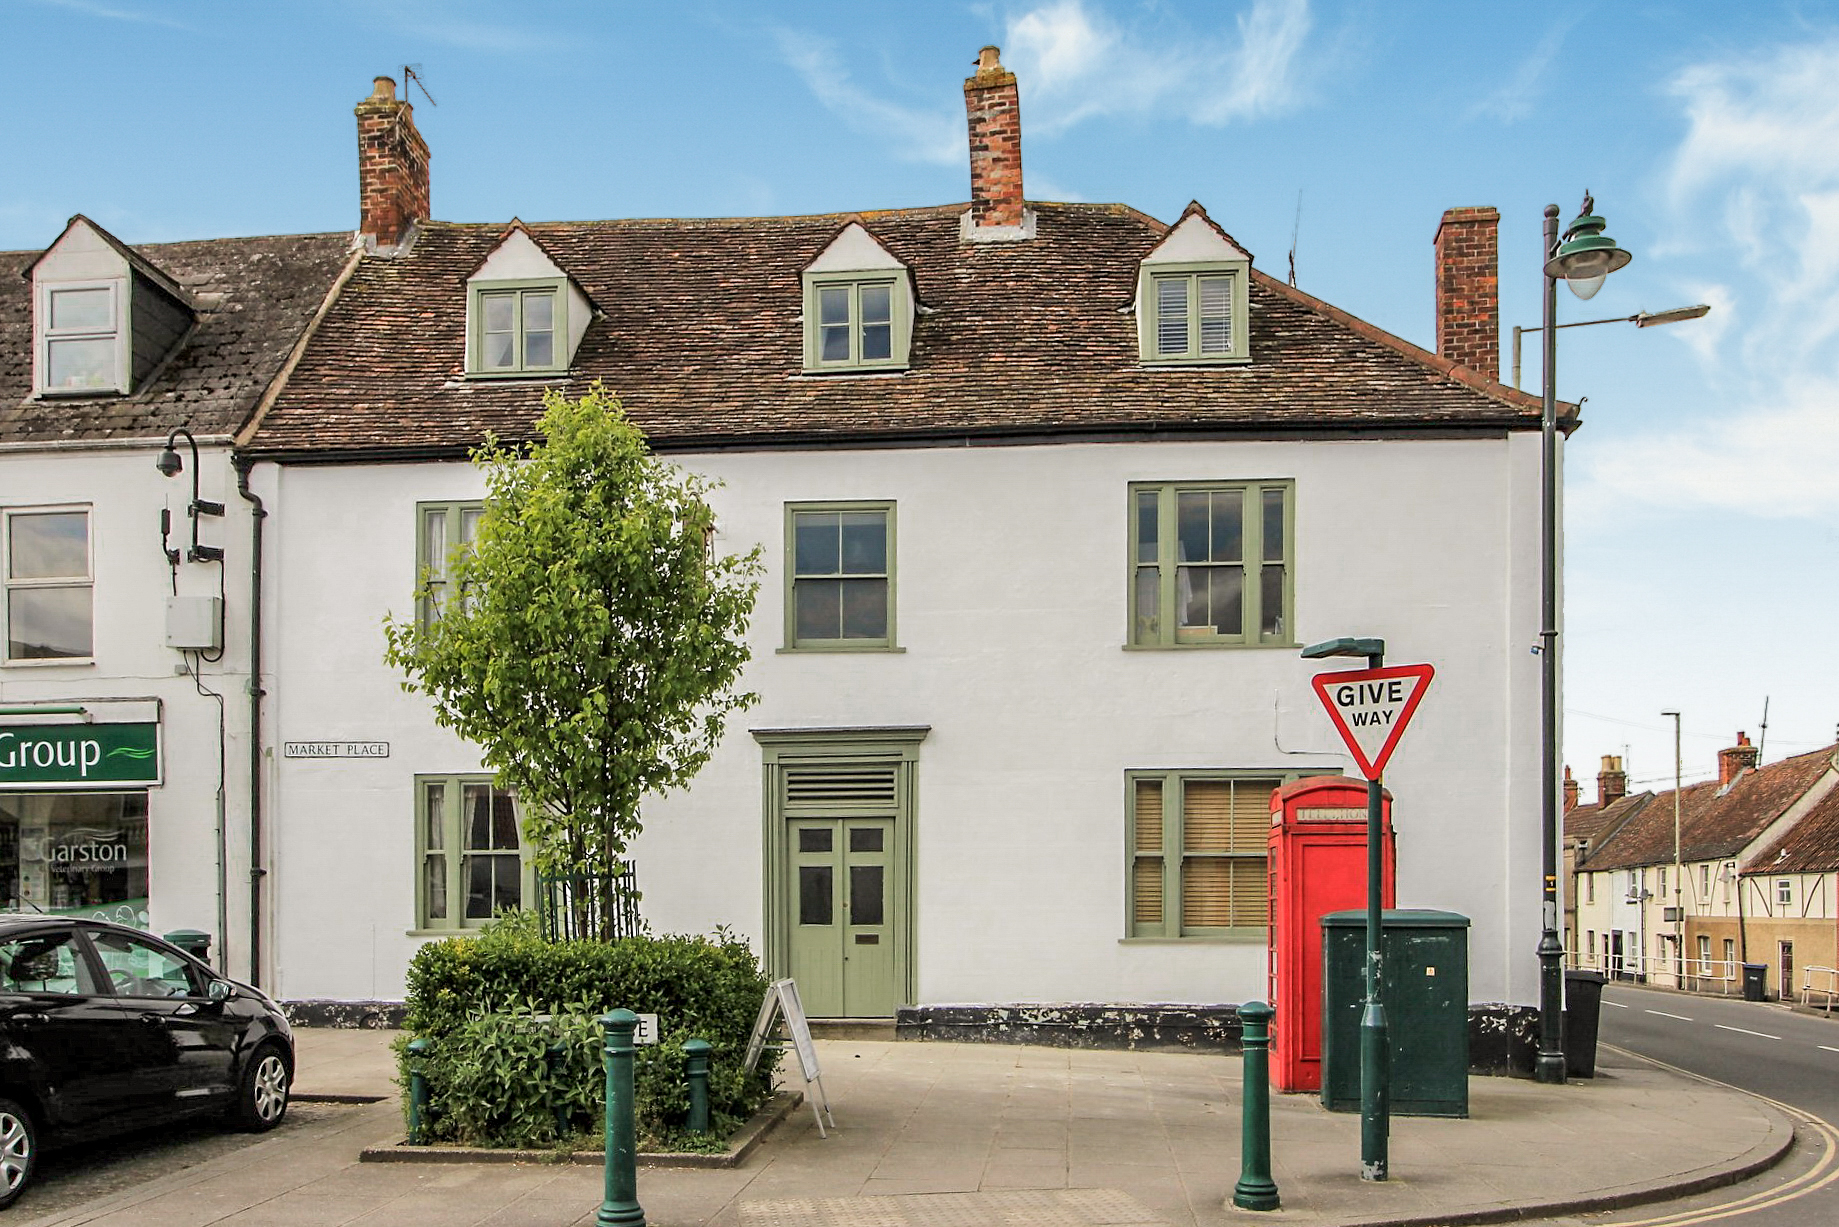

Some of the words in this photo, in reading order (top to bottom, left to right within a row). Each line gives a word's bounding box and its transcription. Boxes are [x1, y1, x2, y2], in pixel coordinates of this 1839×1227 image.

[1336, 681, 1403, 707] GIVE
[1352, 710, 1393, 727] WAY
[0, 732, 100, 777] Group
[288, 744, 340, 755] MARKET
[347, 744, 385, 755] PLACE
[40, 837, 127, 862] Garston
[51, 864, 90, 874] Veterinary
[91, 864, 115, 875] Group
